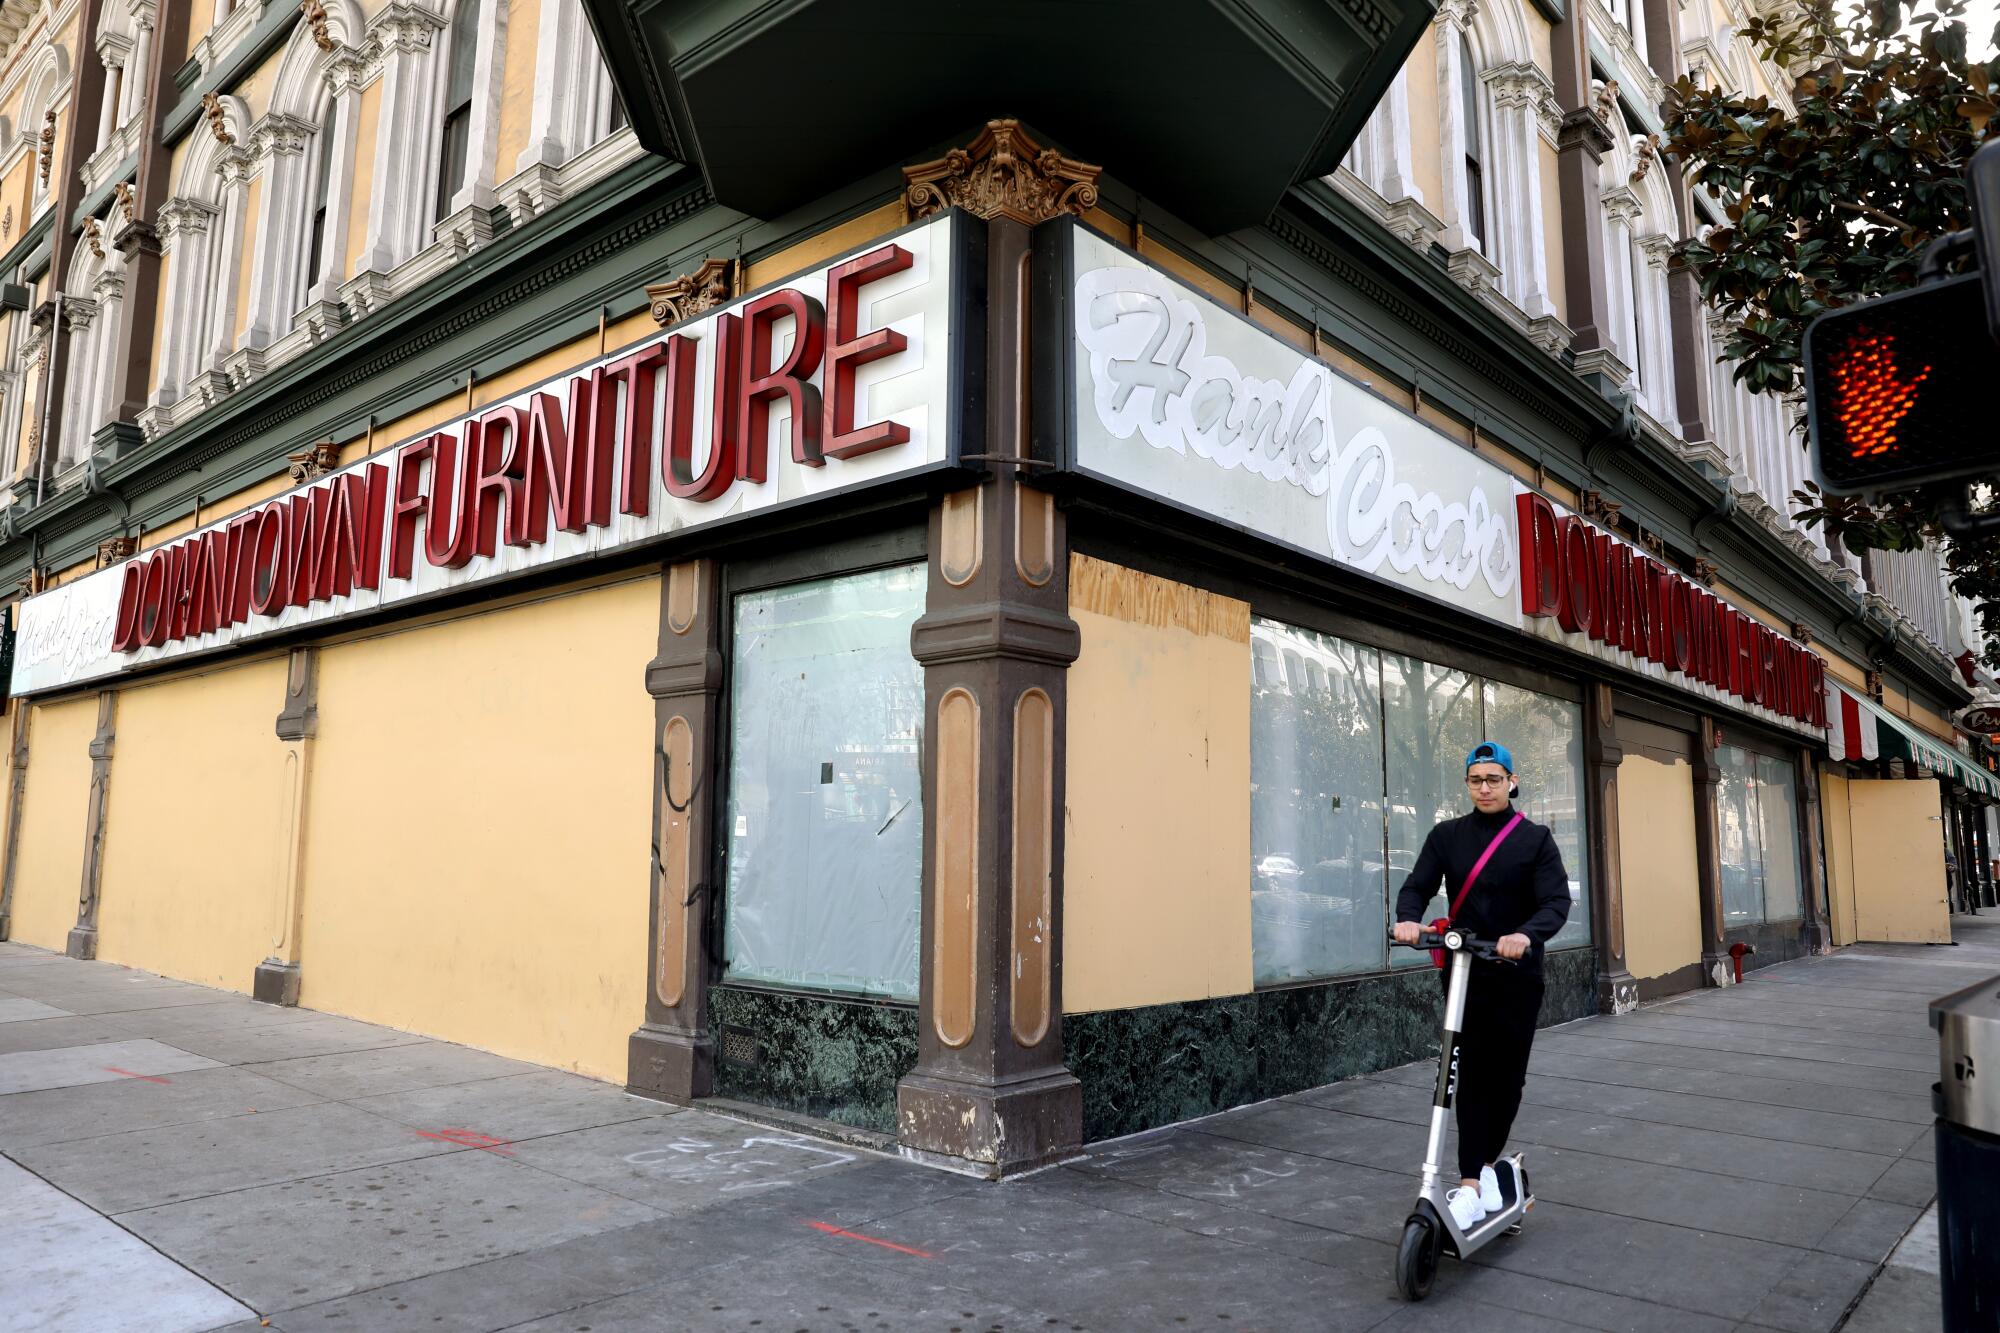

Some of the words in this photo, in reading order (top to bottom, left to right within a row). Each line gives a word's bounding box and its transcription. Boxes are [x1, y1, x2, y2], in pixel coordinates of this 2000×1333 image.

[112, 462, 389, 653] DOWNTOWN
[388, 242, 914, 580] FURNITURE
[1088, 289, 1329, 467] Hank
[1516, 492, 1730, 690] DOWNTOWN
[1727, 610, 1833, 730] FURNITURE
